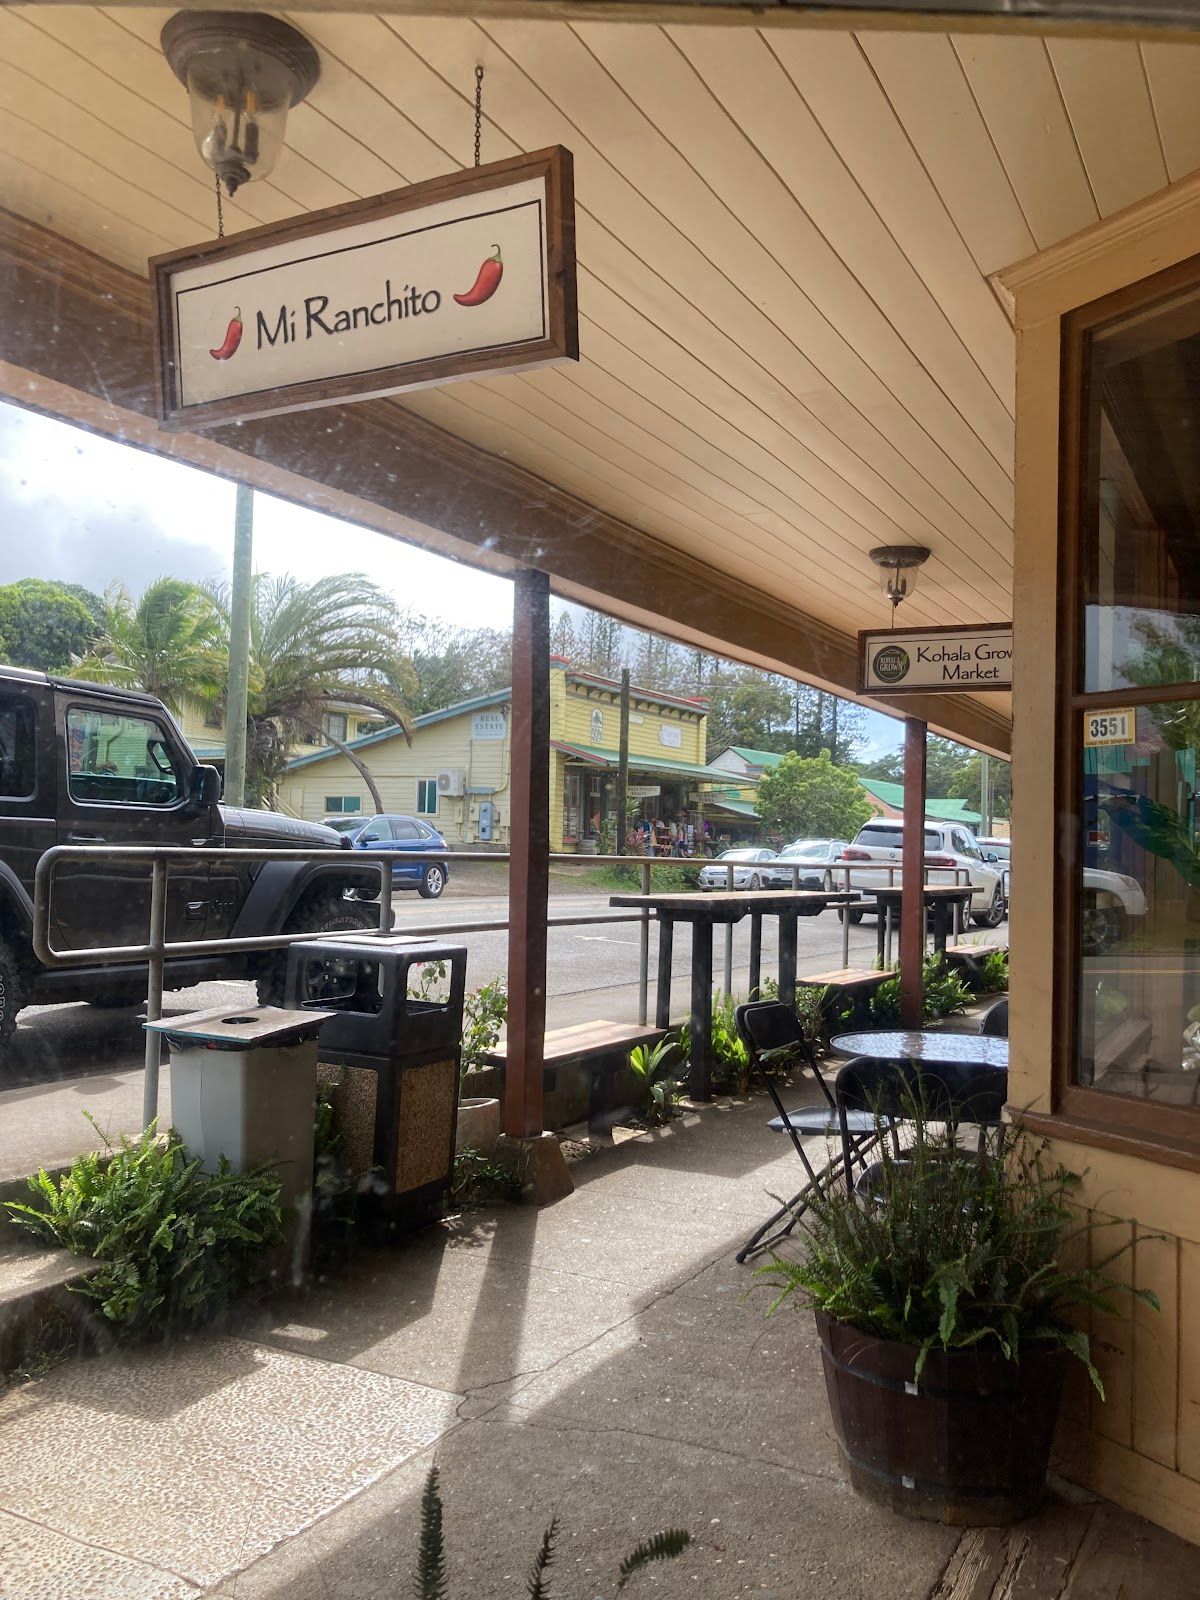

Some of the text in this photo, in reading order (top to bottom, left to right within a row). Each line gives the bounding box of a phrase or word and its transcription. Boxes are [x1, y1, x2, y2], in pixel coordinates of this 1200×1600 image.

[257, 279, 442, 349] Mi Ranchito
[916, 645, 971, 663] Kohala
[942, 663, 1000, 681] Market
[480, 714, 499, 722] REAL
[1090, 715, 1126, 738] 3551
